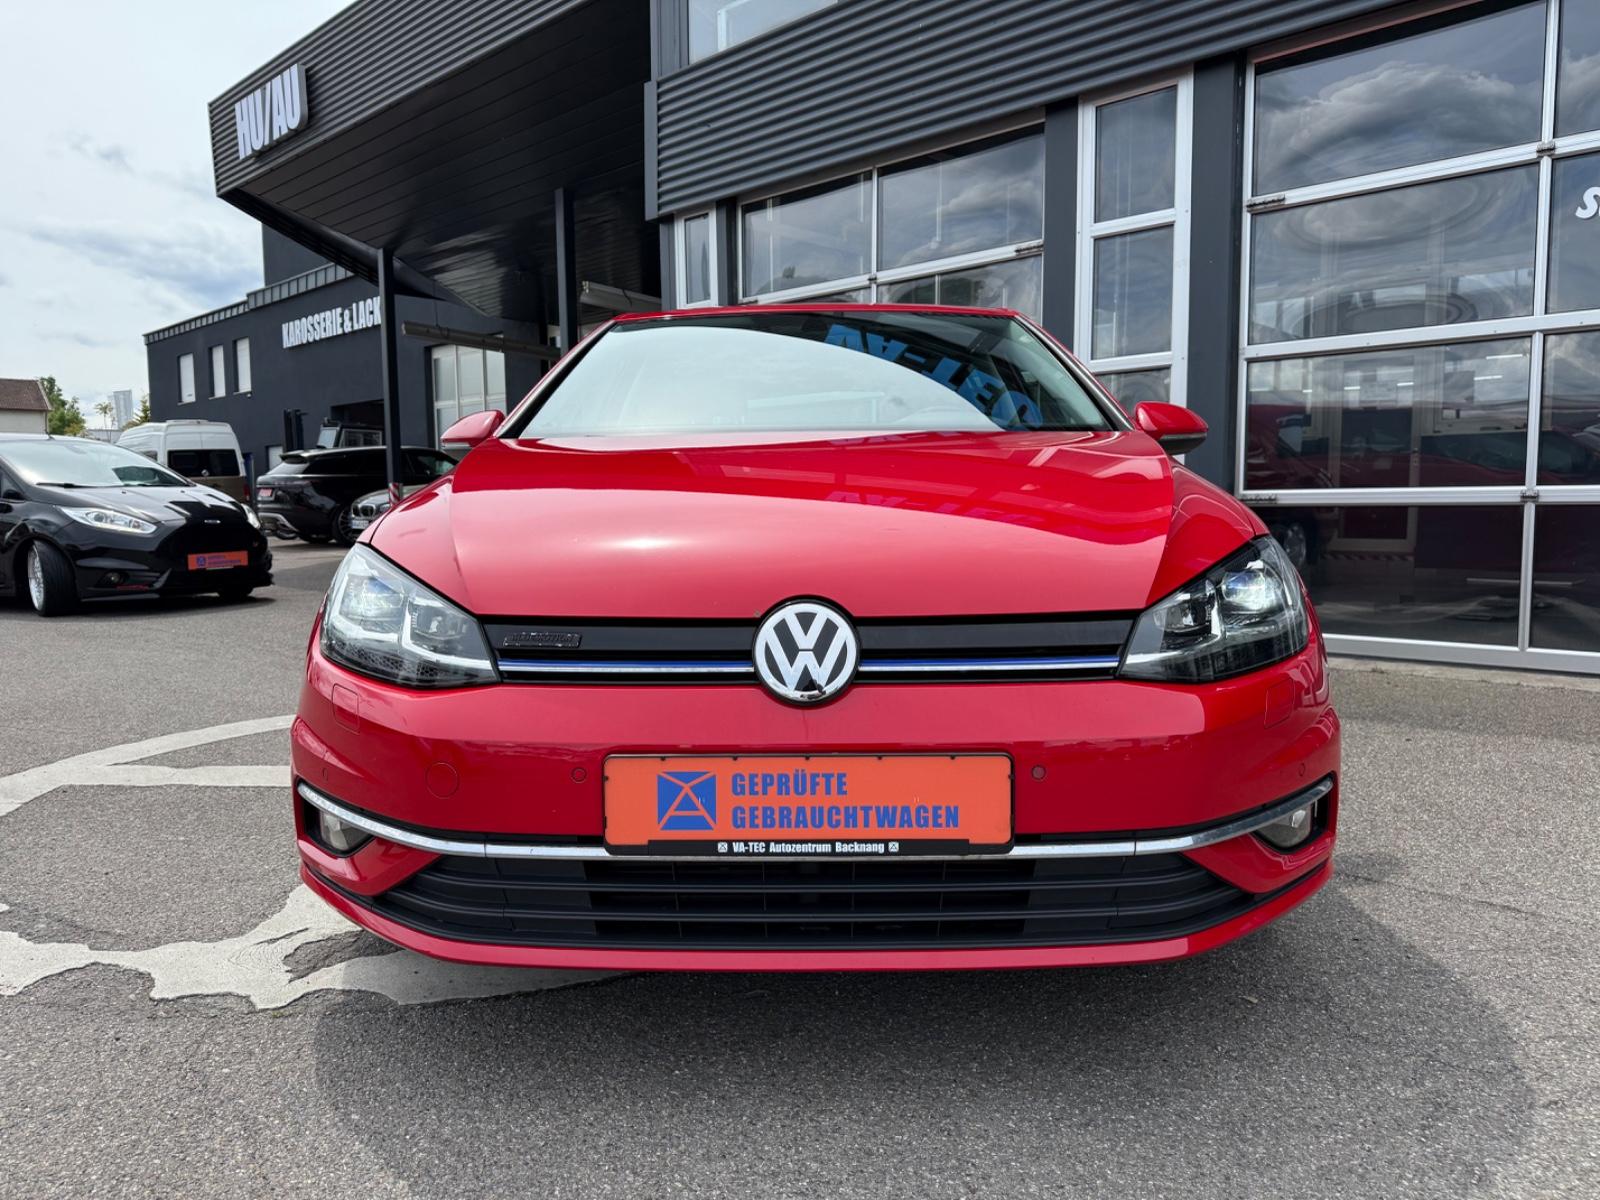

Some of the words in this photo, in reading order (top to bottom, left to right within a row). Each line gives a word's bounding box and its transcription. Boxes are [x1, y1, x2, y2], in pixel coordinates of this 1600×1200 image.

[235, 63, 301, 160] HU/AU
[1575, 186, 1600, 219] S
[282, 307, 343, 348] KAROSSERIE
[344, 309, 352, 333] &
[757, 604, 856, 700] VW
[731, 769, 848, 796] GEPRÜFTE
[731, 805, 959, 829] GEBRAUCHTWAGEN
[732, 842, 766, 853] VA-TEC
[769, 842, 832, 853] Autozentrum
[835, 841, 885, 854] Backnang
